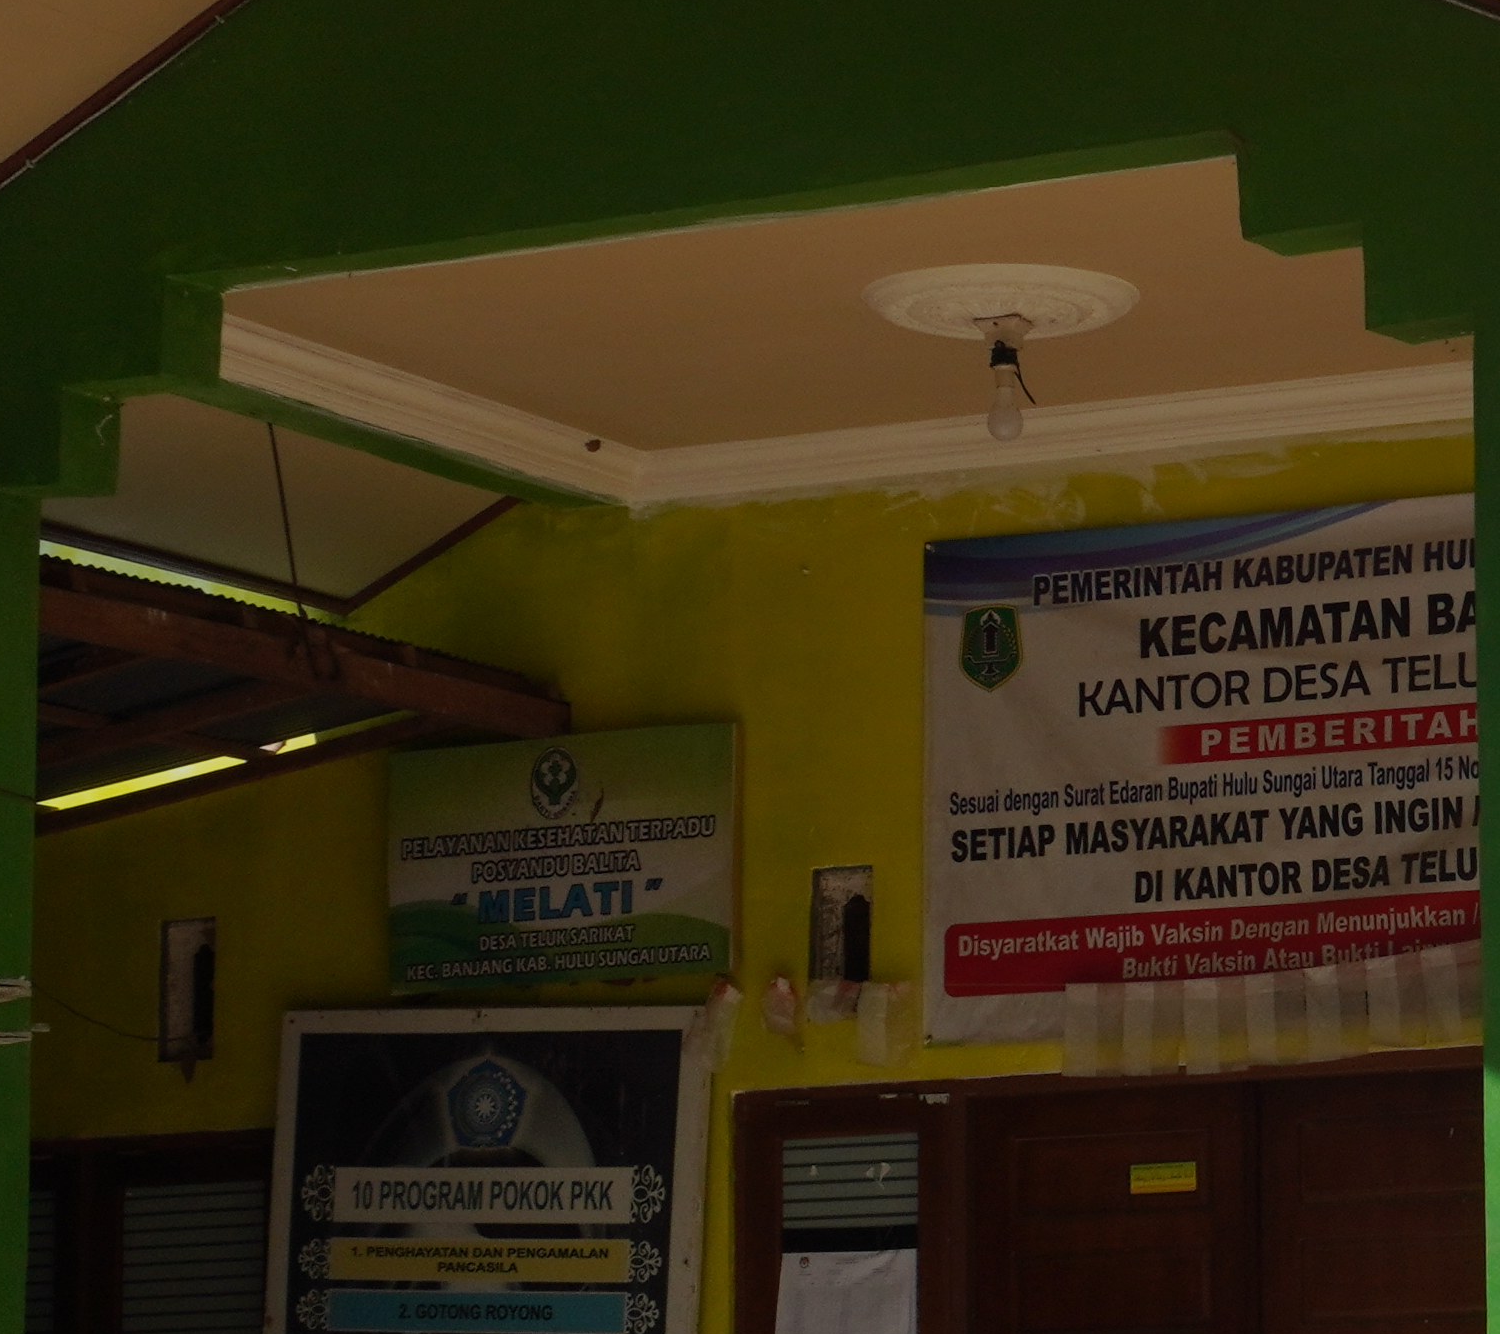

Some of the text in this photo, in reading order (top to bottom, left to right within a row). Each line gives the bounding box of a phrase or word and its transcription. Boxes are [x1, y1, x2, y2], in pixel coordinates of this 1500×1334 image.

[1033, 561, 1222, 606] PEMERINTAH
[1233, 543, 1412, 589] KABUPATEN
[1139, 596, 1411, 659] KECAMATAN
[1078, 653, 1476, 717] KANTOR DESA TELU
[1200, 708, 1478, 757] PEMBERITAH
[950, 789, 999, 815] Sesuai
[1004, 787, 1059, 815] dengan
[1063, 782, 1105, 808] Surat
[1109, 778, 1162, 804] Edaran
[1168, 773, 1218, 802] Bupati
[1222, 771, 1258, 796] Hulu
[1263, 768, 1317, 799] Sungai
[1322, 764, 1363, 789] Utara
[1368, 759, 1430, 789] Tanggal
[1436, 757, 1454, 781] 15
[950, 824, 1055, 862] SETIAP
[1065, 810, 1269, 855] MASYARAKAT
[1278, 803, 1363, 840] YANG
[1374, 796, 1463, 833] INGIN
[479, 880, 634, 924] MELATI
[1134, 847, 1477, 903] DI KANTOR DESA TELU
[1085, 926, 1145, 952] Wajib
[1151, 922, 1224, 947] Vaksin
[1230, 917, 1310, 945] Dengan
[1317, 905, 1466, 937] Menunjukkan
[352, 1181, 614, 1211] 10 PROGRAM POKOK PKK
[399, 1304, 553, 1321] 2. GOTONG ROYONG
